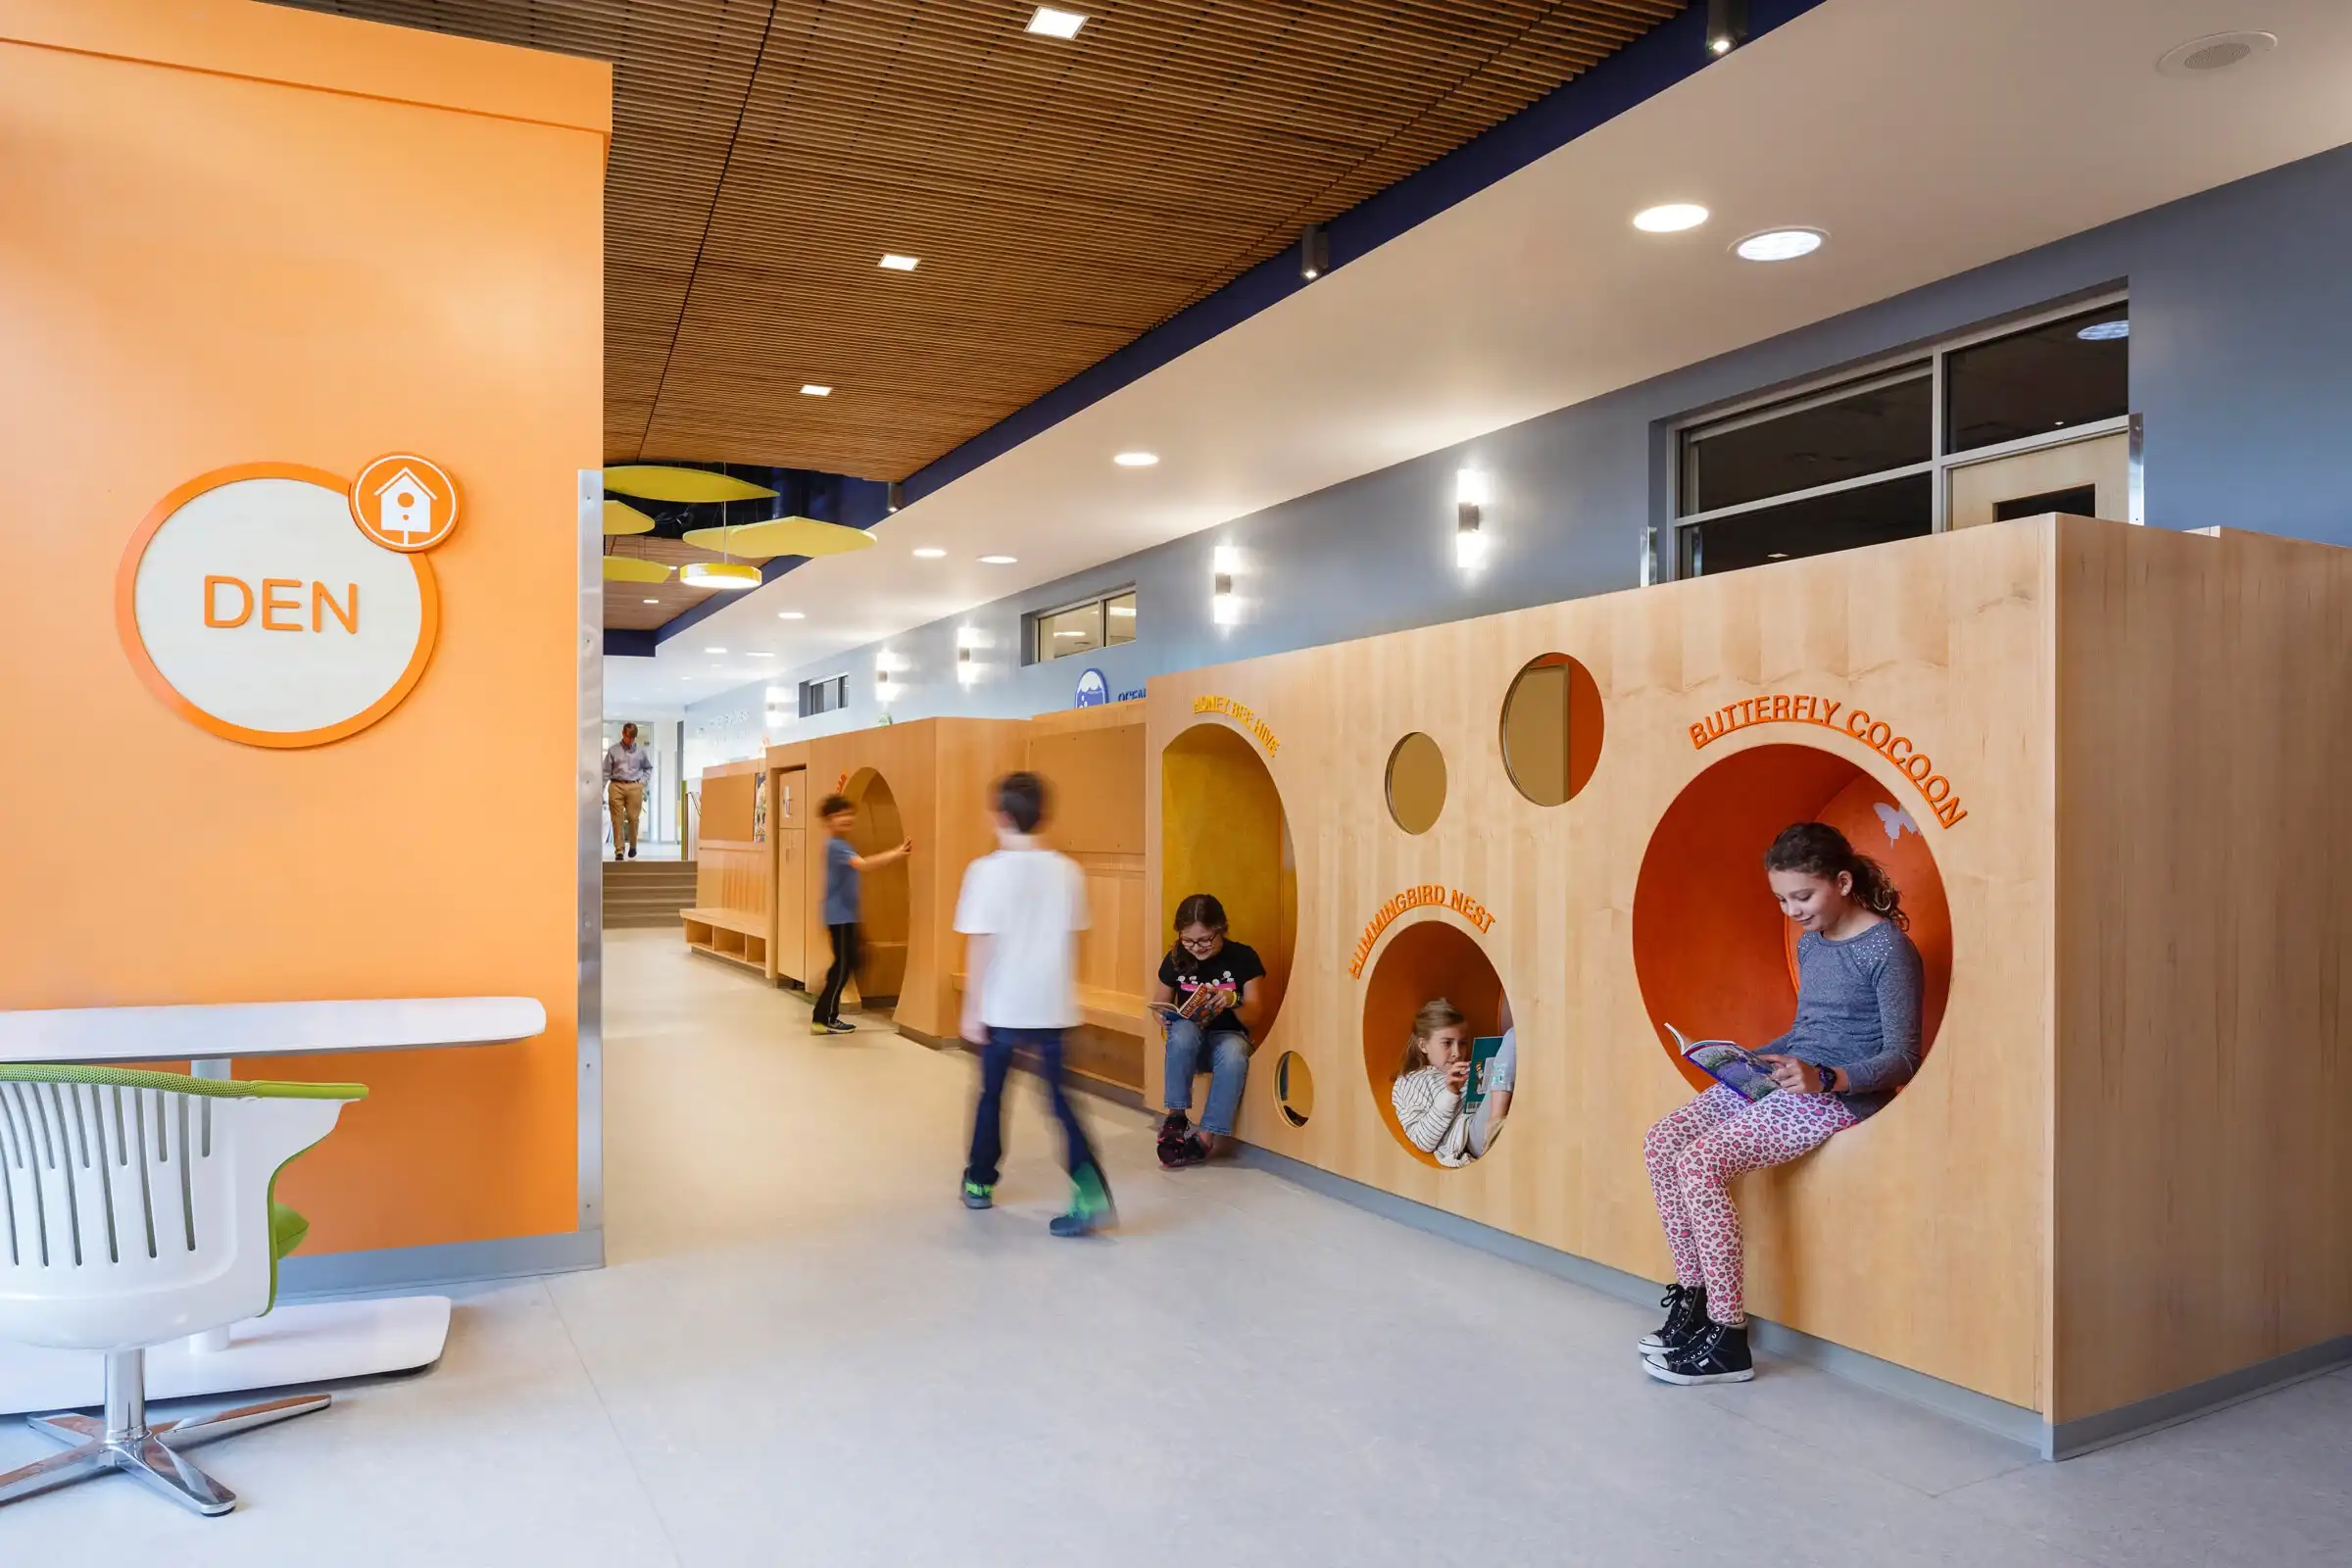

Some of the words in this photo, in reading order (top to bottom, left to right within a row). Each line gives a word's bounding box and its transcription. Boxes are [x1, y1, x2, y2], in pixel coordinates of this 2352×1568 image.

[204, 574, 358, 634] DEN
[1193, 696, 1230, 714] HONEY
[1253, 717, 1280, 758] HIVE
[1688, 694, 1840, 750] BUTTERFLY
[1845, 710, 1968, 829] COCOON
[1348, 885, 1446, 980] HUMMINGBIRD
[1450, 889, 1496, 934] NEST
